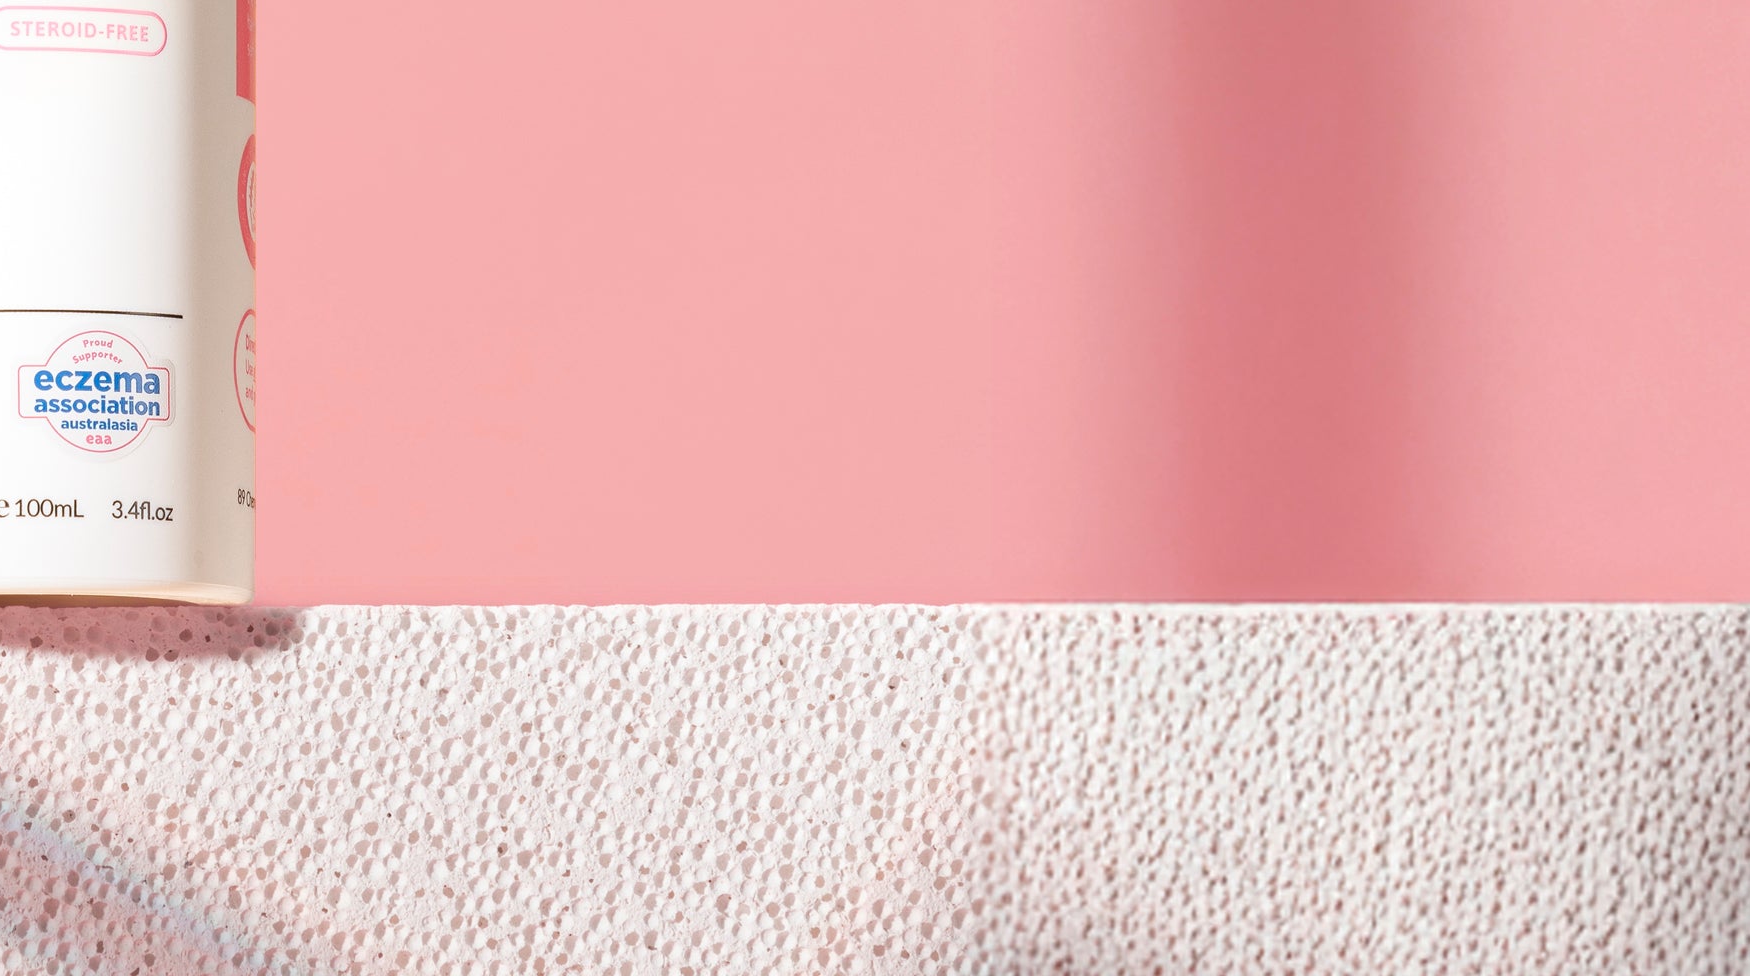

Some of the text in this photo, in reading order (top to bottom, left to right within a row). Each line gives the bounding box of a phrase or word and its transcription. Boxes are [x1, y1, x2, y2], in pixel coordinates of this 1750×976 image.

[10, 21, 150, 42] STEROID-FREE
[82, 339, 114, 349] Proud
[72, 351, 123, 365] Supporter
[33, 369, 161, 395] eczema
[33, 395, 161, 416] association
[60, 418, 139, 431] australasia
[85, 434, 113, 445] eaa
[15, 498, 85, 518] 100mL
